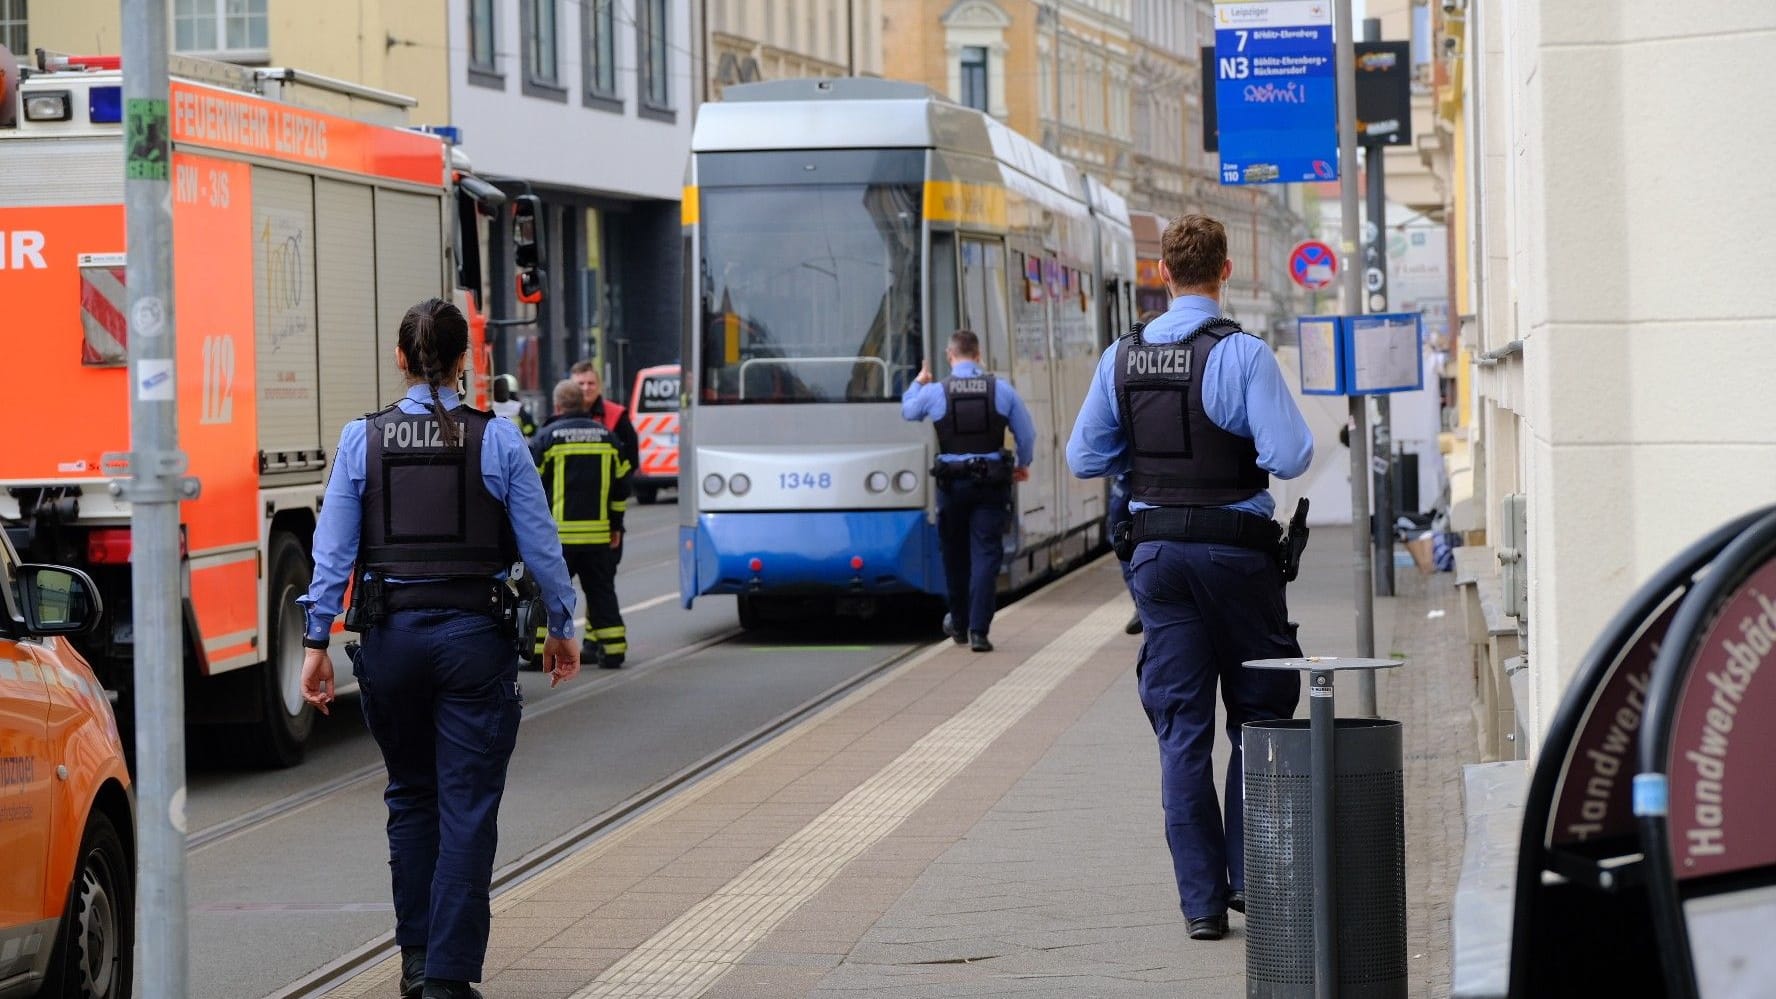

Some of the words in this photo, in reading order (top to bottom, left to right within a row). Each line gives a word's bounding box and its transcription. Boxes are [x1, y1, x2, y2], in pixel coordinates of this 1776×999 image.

[1235, 30, 1248, 52] 7
[1220, 57, 1249, 79] N3
[174, 91, 270, 148] FEUERWEHR
[274, 111, 328, 159] LEIPZIG
[176, 165, 199, 204] RW
[1224, 171, 1239, 182] 110
[0, 231, 48, 270] R
[1127, 349, 1191, 375] POLIZEI
[200, 335, 235, 425] 112
[645, 379, 681, 399] NOT
[950, 380, 987, 393] POLIZEI
[383, 420, 465, 448] POLIZI
[778, 472, 832, 489] 1348
